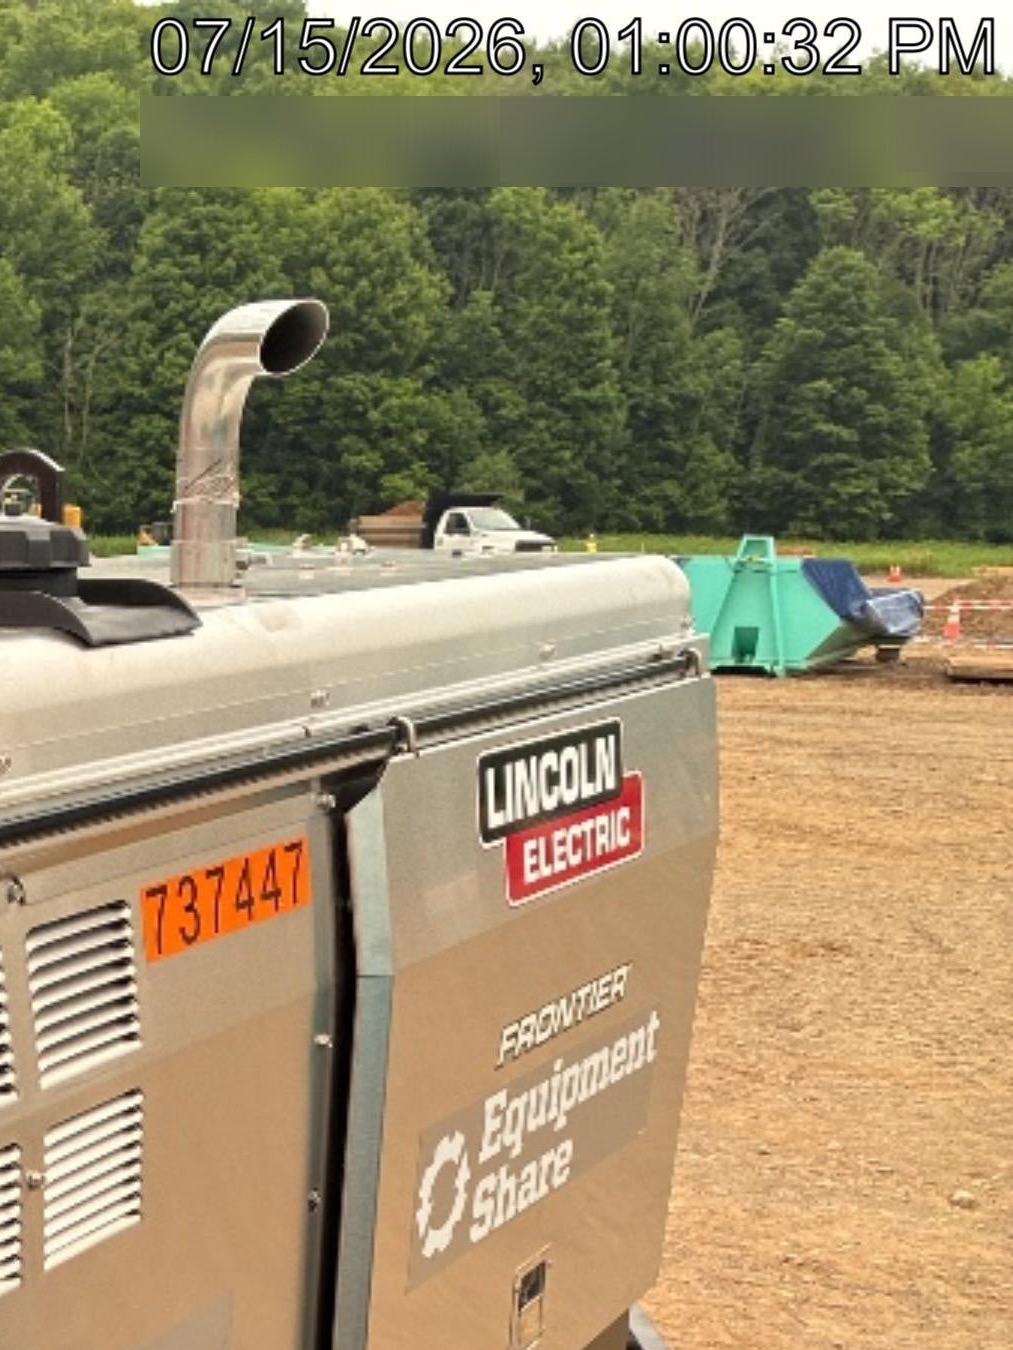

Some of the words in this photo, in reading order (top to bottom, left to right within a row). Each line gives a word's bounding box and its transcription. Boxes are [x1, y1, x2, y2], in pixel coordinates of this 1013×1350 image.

[485, 734, 616, 829] LINCOLN
[146, 840, 303, 955] 737447
[523, 806, 630, 886] ELECTRIC
[496, 962, 631, 1068] FRONTIER
[479, 1010, 660, 1165] Equipment
[469, 1139, 574, 1243] Share
